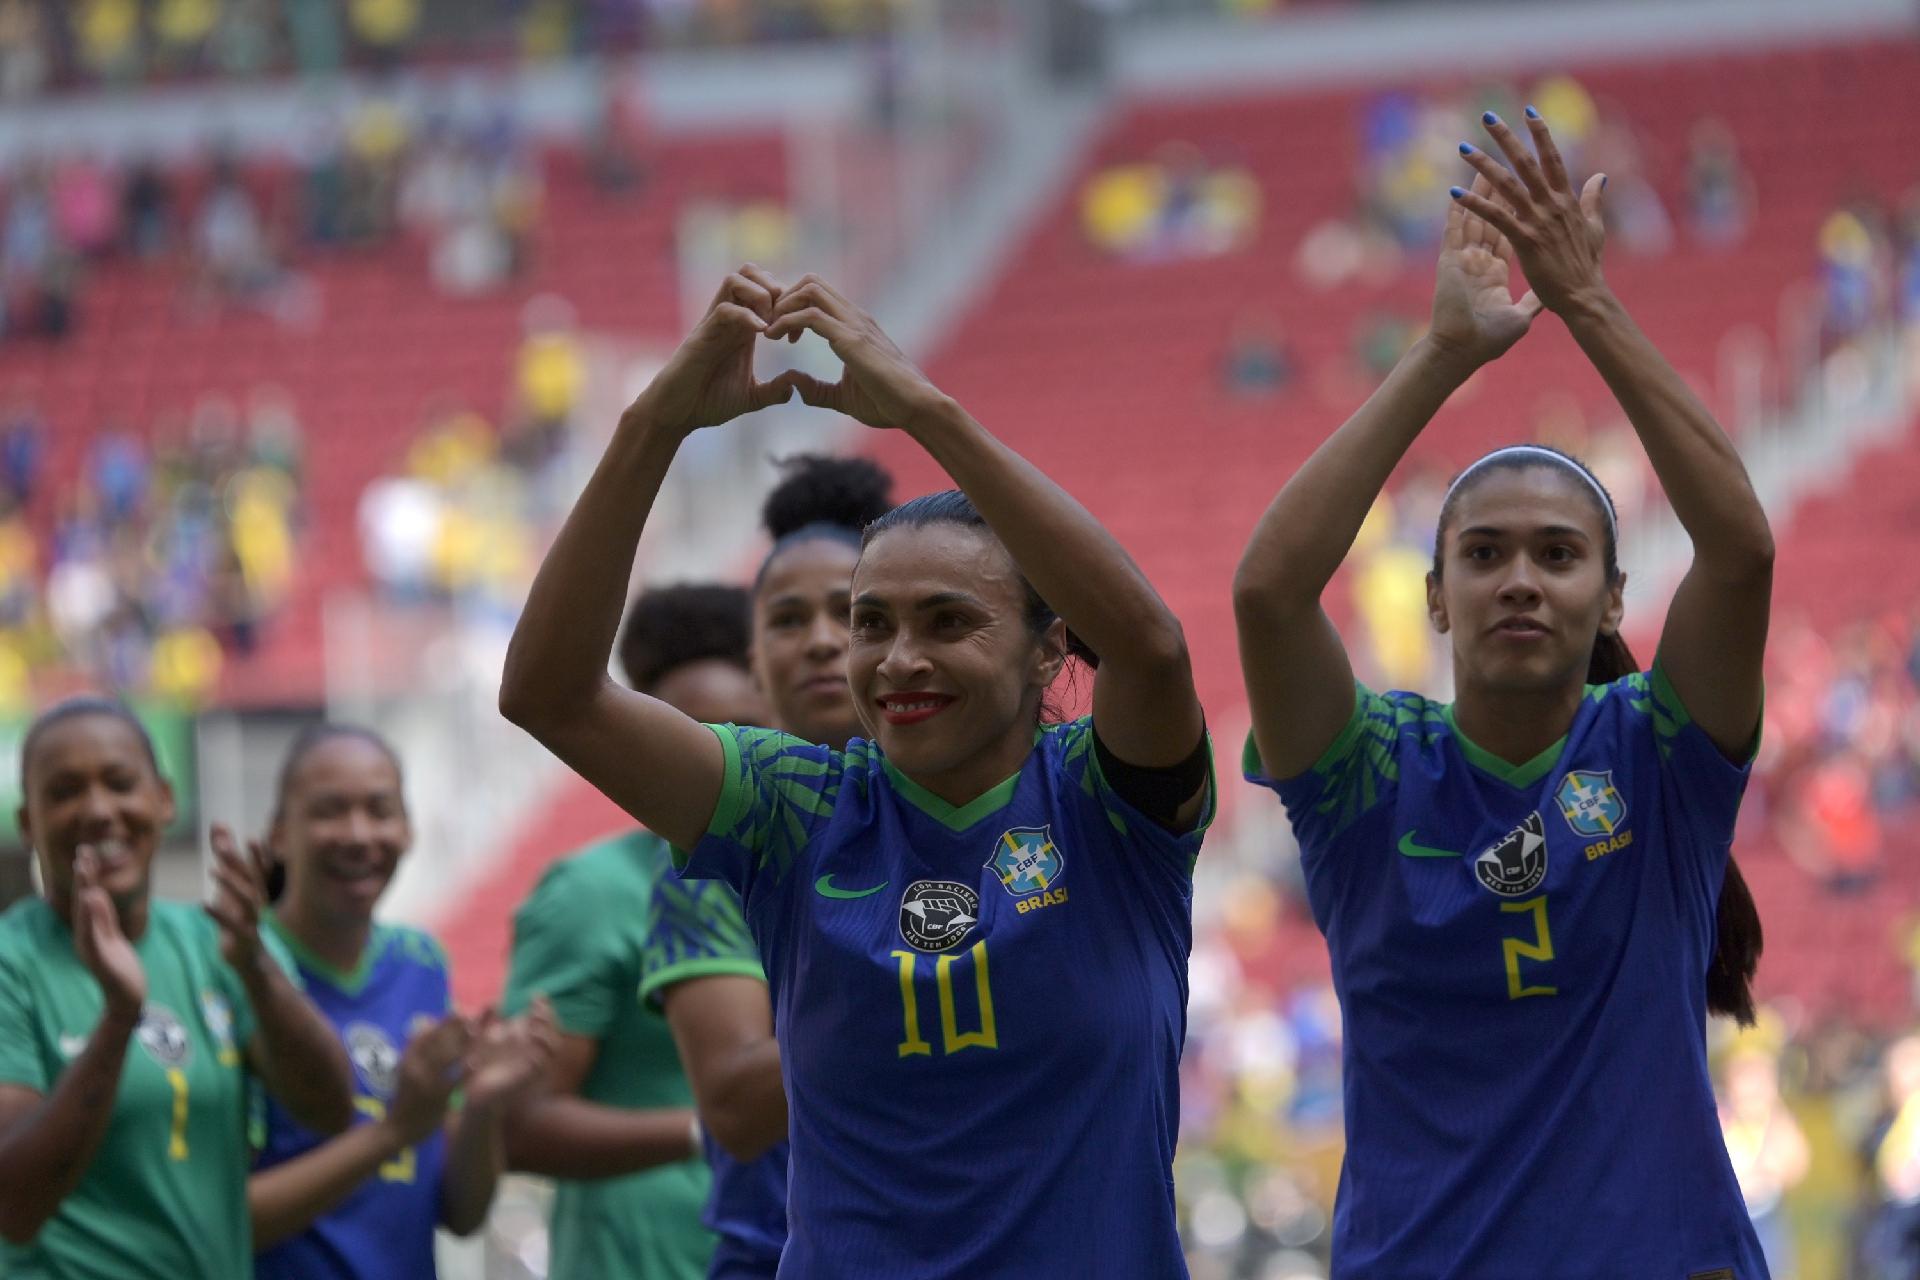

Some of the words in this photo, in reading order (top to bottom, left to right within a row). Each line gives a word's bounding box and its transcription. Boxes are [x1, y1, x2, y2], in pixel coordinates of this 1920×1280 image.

[1579, 795, 1600, 811] CBF
[1584, 829, 1633, 861] BRASI
[1016, 853, 1039, 873] CBF
[938, 884, 978, 909] RACISMO
[1016, 887, 1069, 914] BRASI
[1500, 895, 1557, 999] 2
[891, 939, 998, 1057] 10
